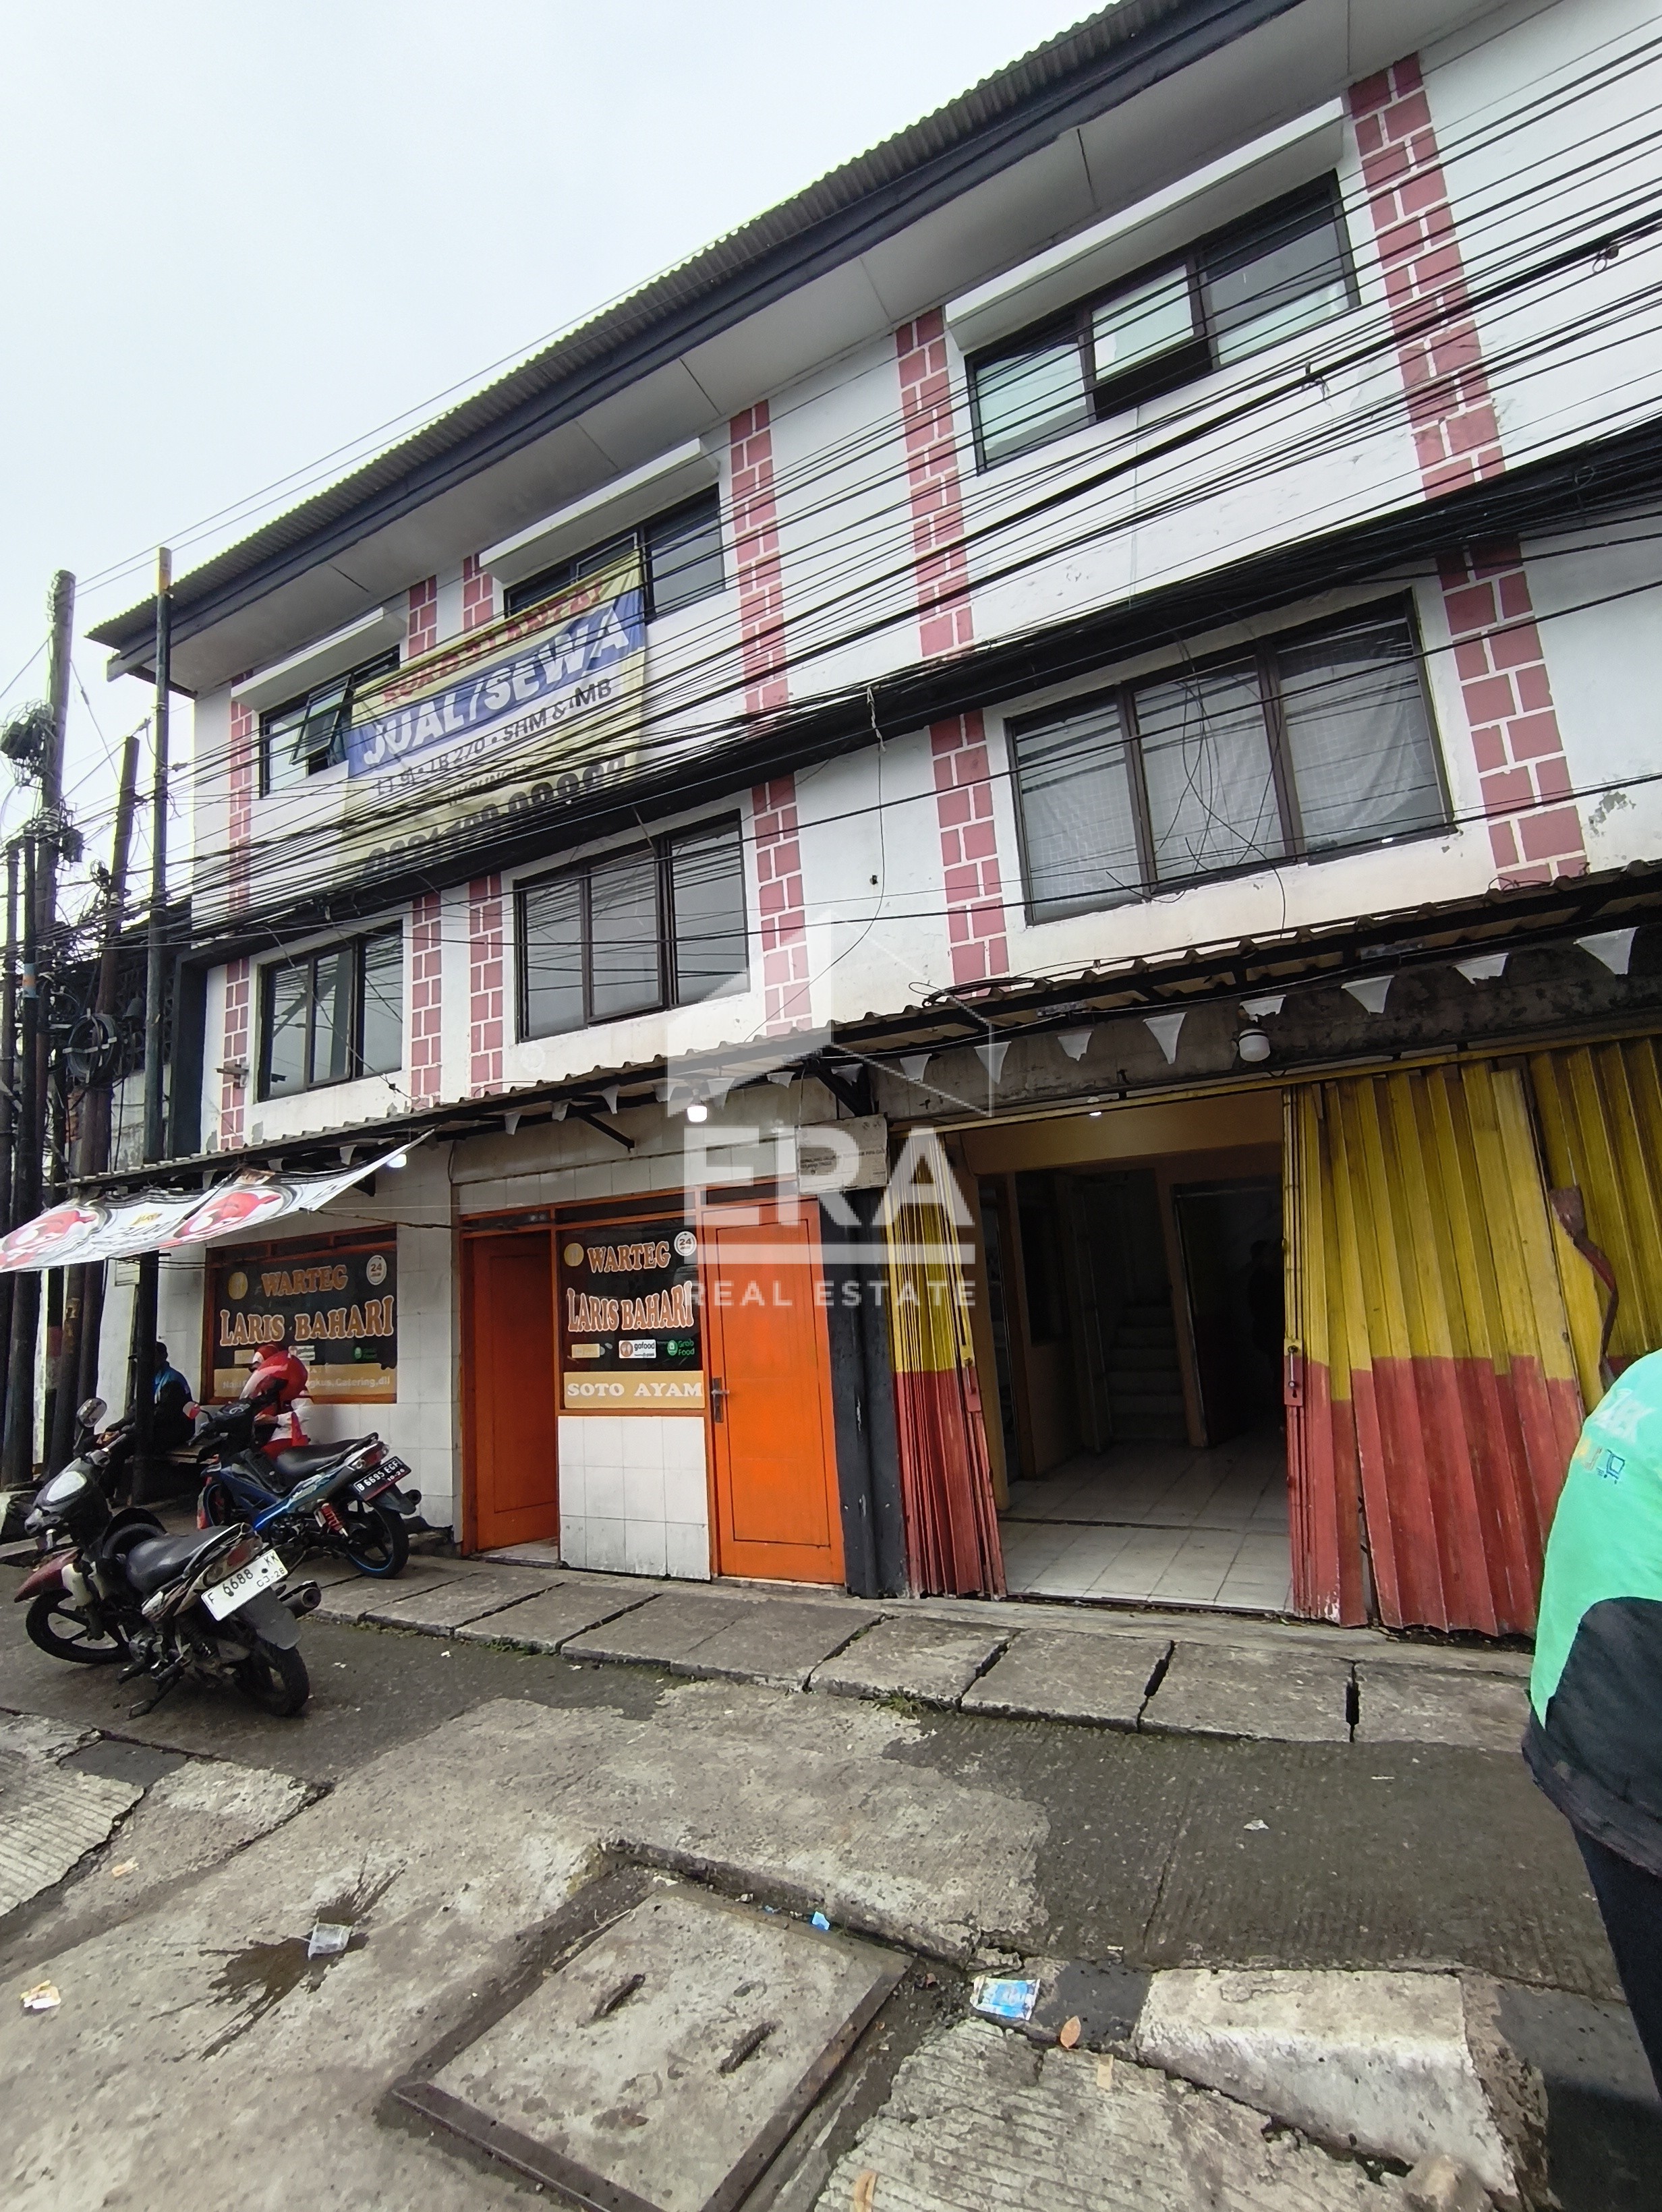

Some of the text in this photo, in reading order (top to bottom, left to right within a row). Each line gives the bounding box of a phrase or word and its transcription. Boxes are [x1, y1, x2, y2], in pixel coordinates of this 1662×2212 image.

[364, 604, 629, 765] JUAL/SEWA
[503, 706, 547, 742] SHM
[679, 1238, 692, 1246] 24
[370, 1262, 382, 1272] 24
[587, 1241, 671, 1273] WARTEG
[261, 1264, 349, 1298] WARTEG
[567, 1280, 694, 1332] LARIS BAHARI
[220, 1294, 395, 1347] LARIS BAHARI
[634, 1341, 656, 1351] gofood
[678, 1338, 694, 1347] Grab
[678, 1347, 695, 1356] Food
[567, 1382, 704, 1397] SOTO AYAM
[356, 1483, 365, 1491] B
[364, 1471, 385, 1486] 6695
[207, 1592, 214, 1604] F
[223, 1569, 254, 1595] 6688
